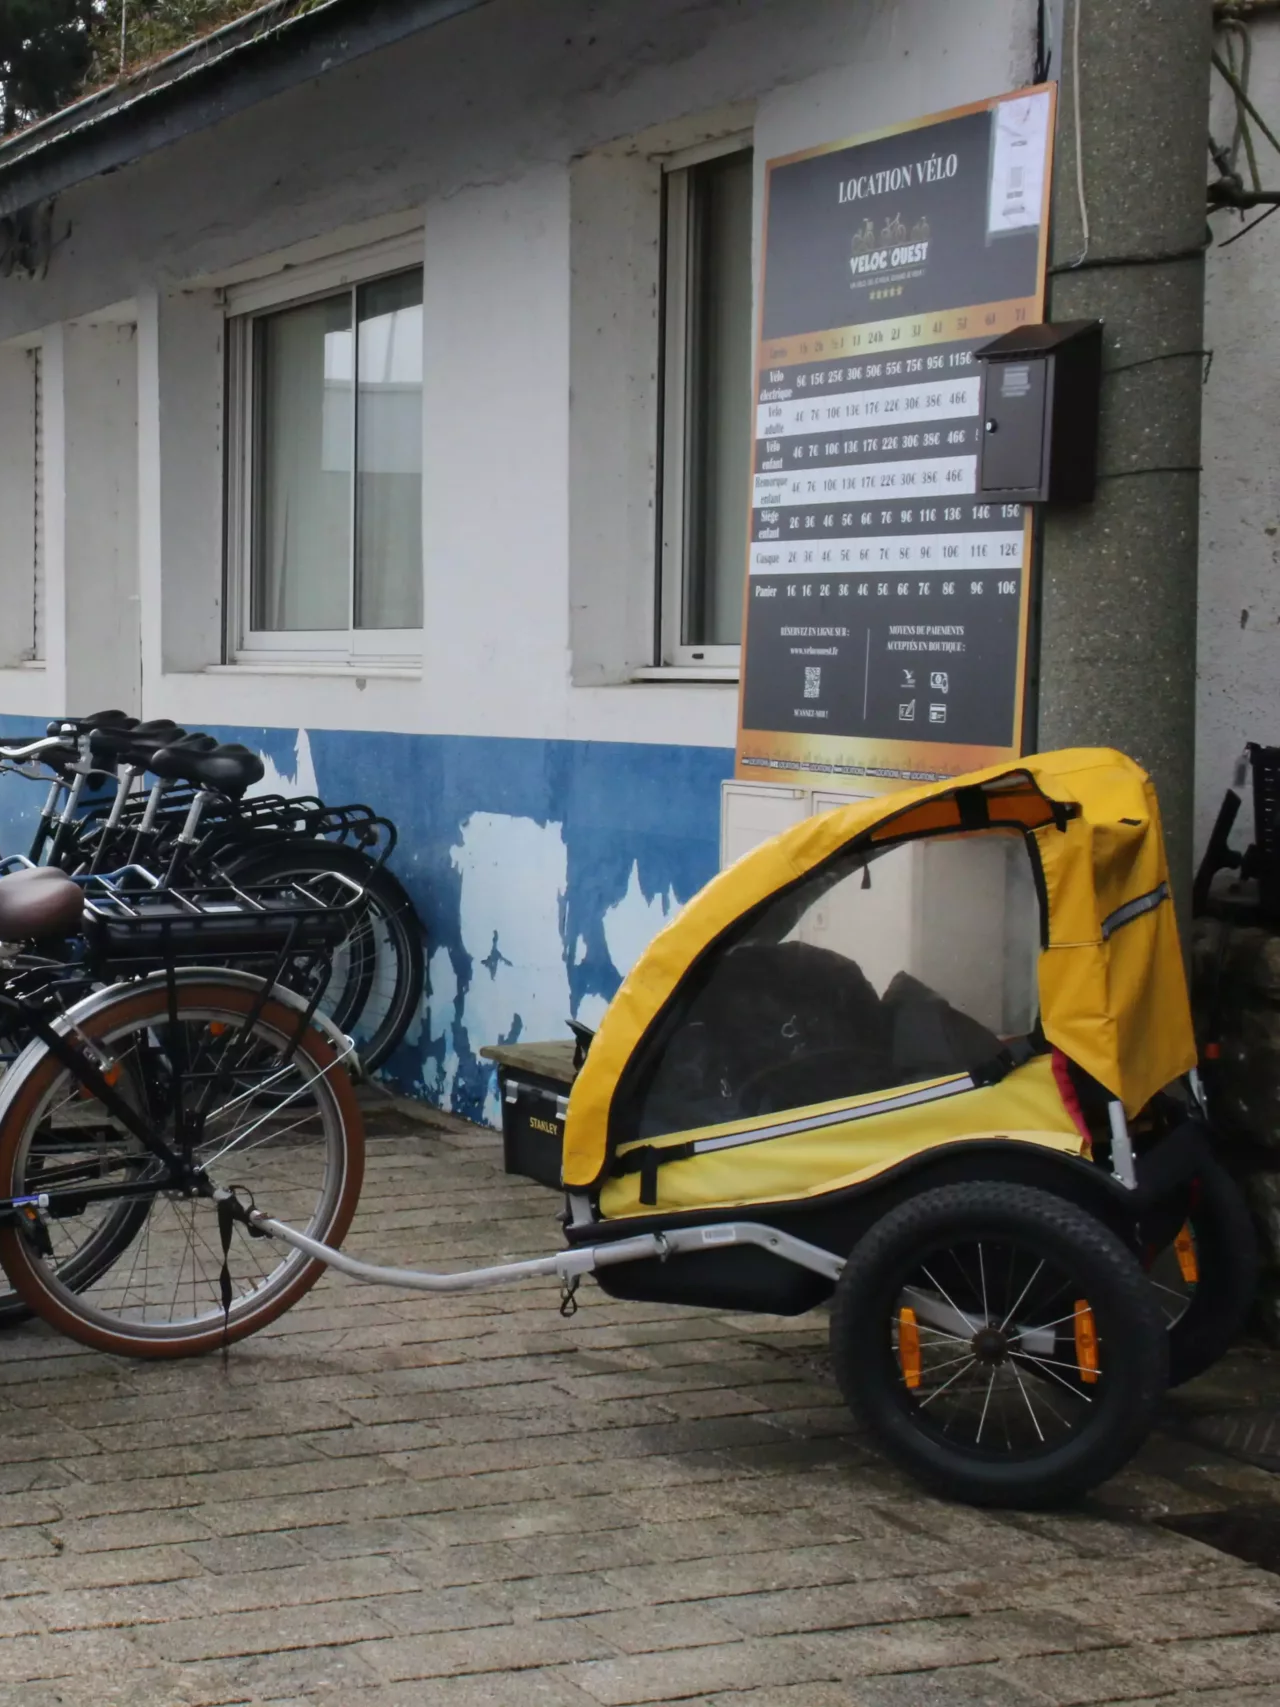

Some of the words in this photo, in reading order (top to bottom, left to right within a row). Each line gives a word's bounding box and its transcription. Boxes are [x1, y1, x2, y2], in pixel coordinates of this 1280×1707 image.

[838, 164, 913, 203] LOCATION
[916, 153, 958, 184] VÉLO
[868, 331, 884, 344] 24h
[796, 374, 806, 388] 8€
[810, 372, 824, 386] 15€
[828, 370, 844, 384] 25€
[846, 366, 862, 380] 30€
[866, 364, 882, 378] 50€
[886, 361, 902, 375] 55€
[906, 358, 923, 372] 75€
[927, 354, 944, 370] 95€
[949, 351, 972, 366] 115€
[795, 410, 804, 422] 4€
[811, 409, 820, 420] 7€
[827, 406, 840, 418] 10€
[846, 404, 860, 416] 13€
[865, 402, 879, 415] 17€
[884, 398, 900, 412] 22€
[904, 396, 920, 410] 30€
[926, 394, 942, 407] 38€
[949, 391, 966, 404] 46€
[792, 446, 804, 458] 4€
[808, 444, 818, 458] 7€
[825, 442, 840, 456] 10€
[844, 440, 858, 454] 13€
[863, 438, 878, 452] 17€
[882, 436, 898, 450] 22€
[902, 434, 920, 448] 30€
[922, 432, 940, 446] 38€
[946, 430, 966, 444] 46€
[762, 458, 783, 470] enfant
[792, 482, 801, 493] 4€
[807, 480, 816, 492] 7€
[824, 478, 838, 491] 10€
[842, 478, 856, 490] 13€
[862, 476, 876, 488] 17€
[880, 474, 896, 487] 22€
[900, 472, 916, 486] 30€
[922, 470, 938, 484] 38€
[946, 468, 963, 482] 46€
[789, 516, 800, 529] 2€
[804, 516, 816, 528] 3€
[823, 514, 834, 528] 4€
[842, 513, 852, 526] 5€
[860, 512, 872, 526] 6€
[881, 511, 892, 524] 7€
[900, 510, 912, 522] 9€
[920, 508, 936, 522] 11€
[944, 507, 962, 520] 13€
[972, 506, 990, 519] 14€
[1001, 504, 1020, 518] 15€
[758, 528, 780, 539] enfant
[788, 552, 798, 563] 2€
[804, 550, 813, 562] 3€
[822, 550, 832, 562] 4€
[840, 549, 850, 561] 5€
[860, 548, 870, 560] 6€
[880, 548, 890, 560] 7€
[900, 547, 910, 560] 8€
[920, 546, 932, 558] 9€
[942, 545, 959, 558] 10€
[971, 544, 988, 557] 11€
[1000, 543, 1018, 556] 12€
[755, 585, 778, 597] Panier
[786, 584, 796, 596] 1€
[802, 584, 812, 596] 1€
[820, 584, 830, 596] 2€
[838, 584, 849, 596] 3€
[858, 584, 868, 596] 4€
[877, 583, 888, 596] 5€
[897, 582, 909, 596] 6€
[918, 582, 930, 596] 7€
[942, 582, 955, 595] 8€
[970, 582, 983, 594] 9€
[998, 581, 1016, 594] 10€
[888, 625, 916, 635] MOYENS
[916, 626, 925, 635] DE
[926, 625, 964, 636] PAIEMENTS
[918, 642, 927, 651] EN
[530, 1116, 558, 1136] STANLEY
